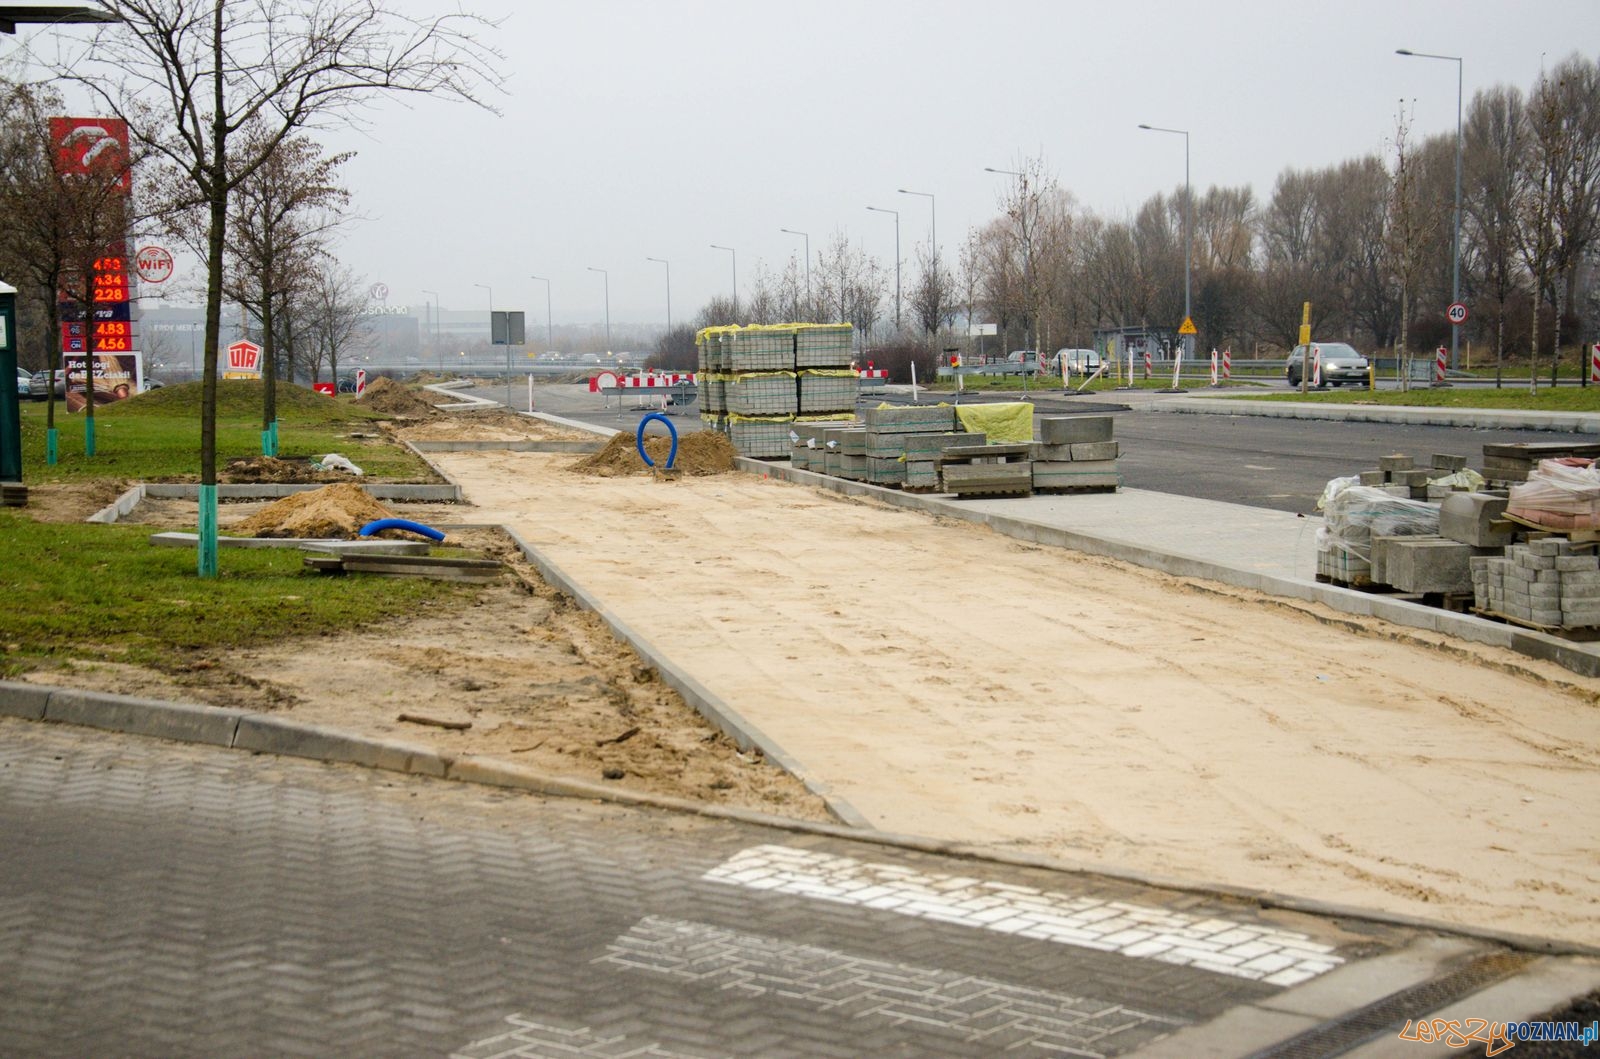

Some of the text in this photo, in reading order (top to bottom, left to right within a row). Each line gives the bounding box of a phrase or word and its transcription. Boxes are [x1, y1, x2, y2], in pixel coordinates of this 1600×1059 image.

[140, 259, 170, 270] WiFi
[1450, 307, 1464, 318] 40
[97, 323, 125, 334] 4.83
[97, 338, 126, 349] 4.56
[229, 342, 259, 368] UTA
[68, 360, 87, 369] Hot
